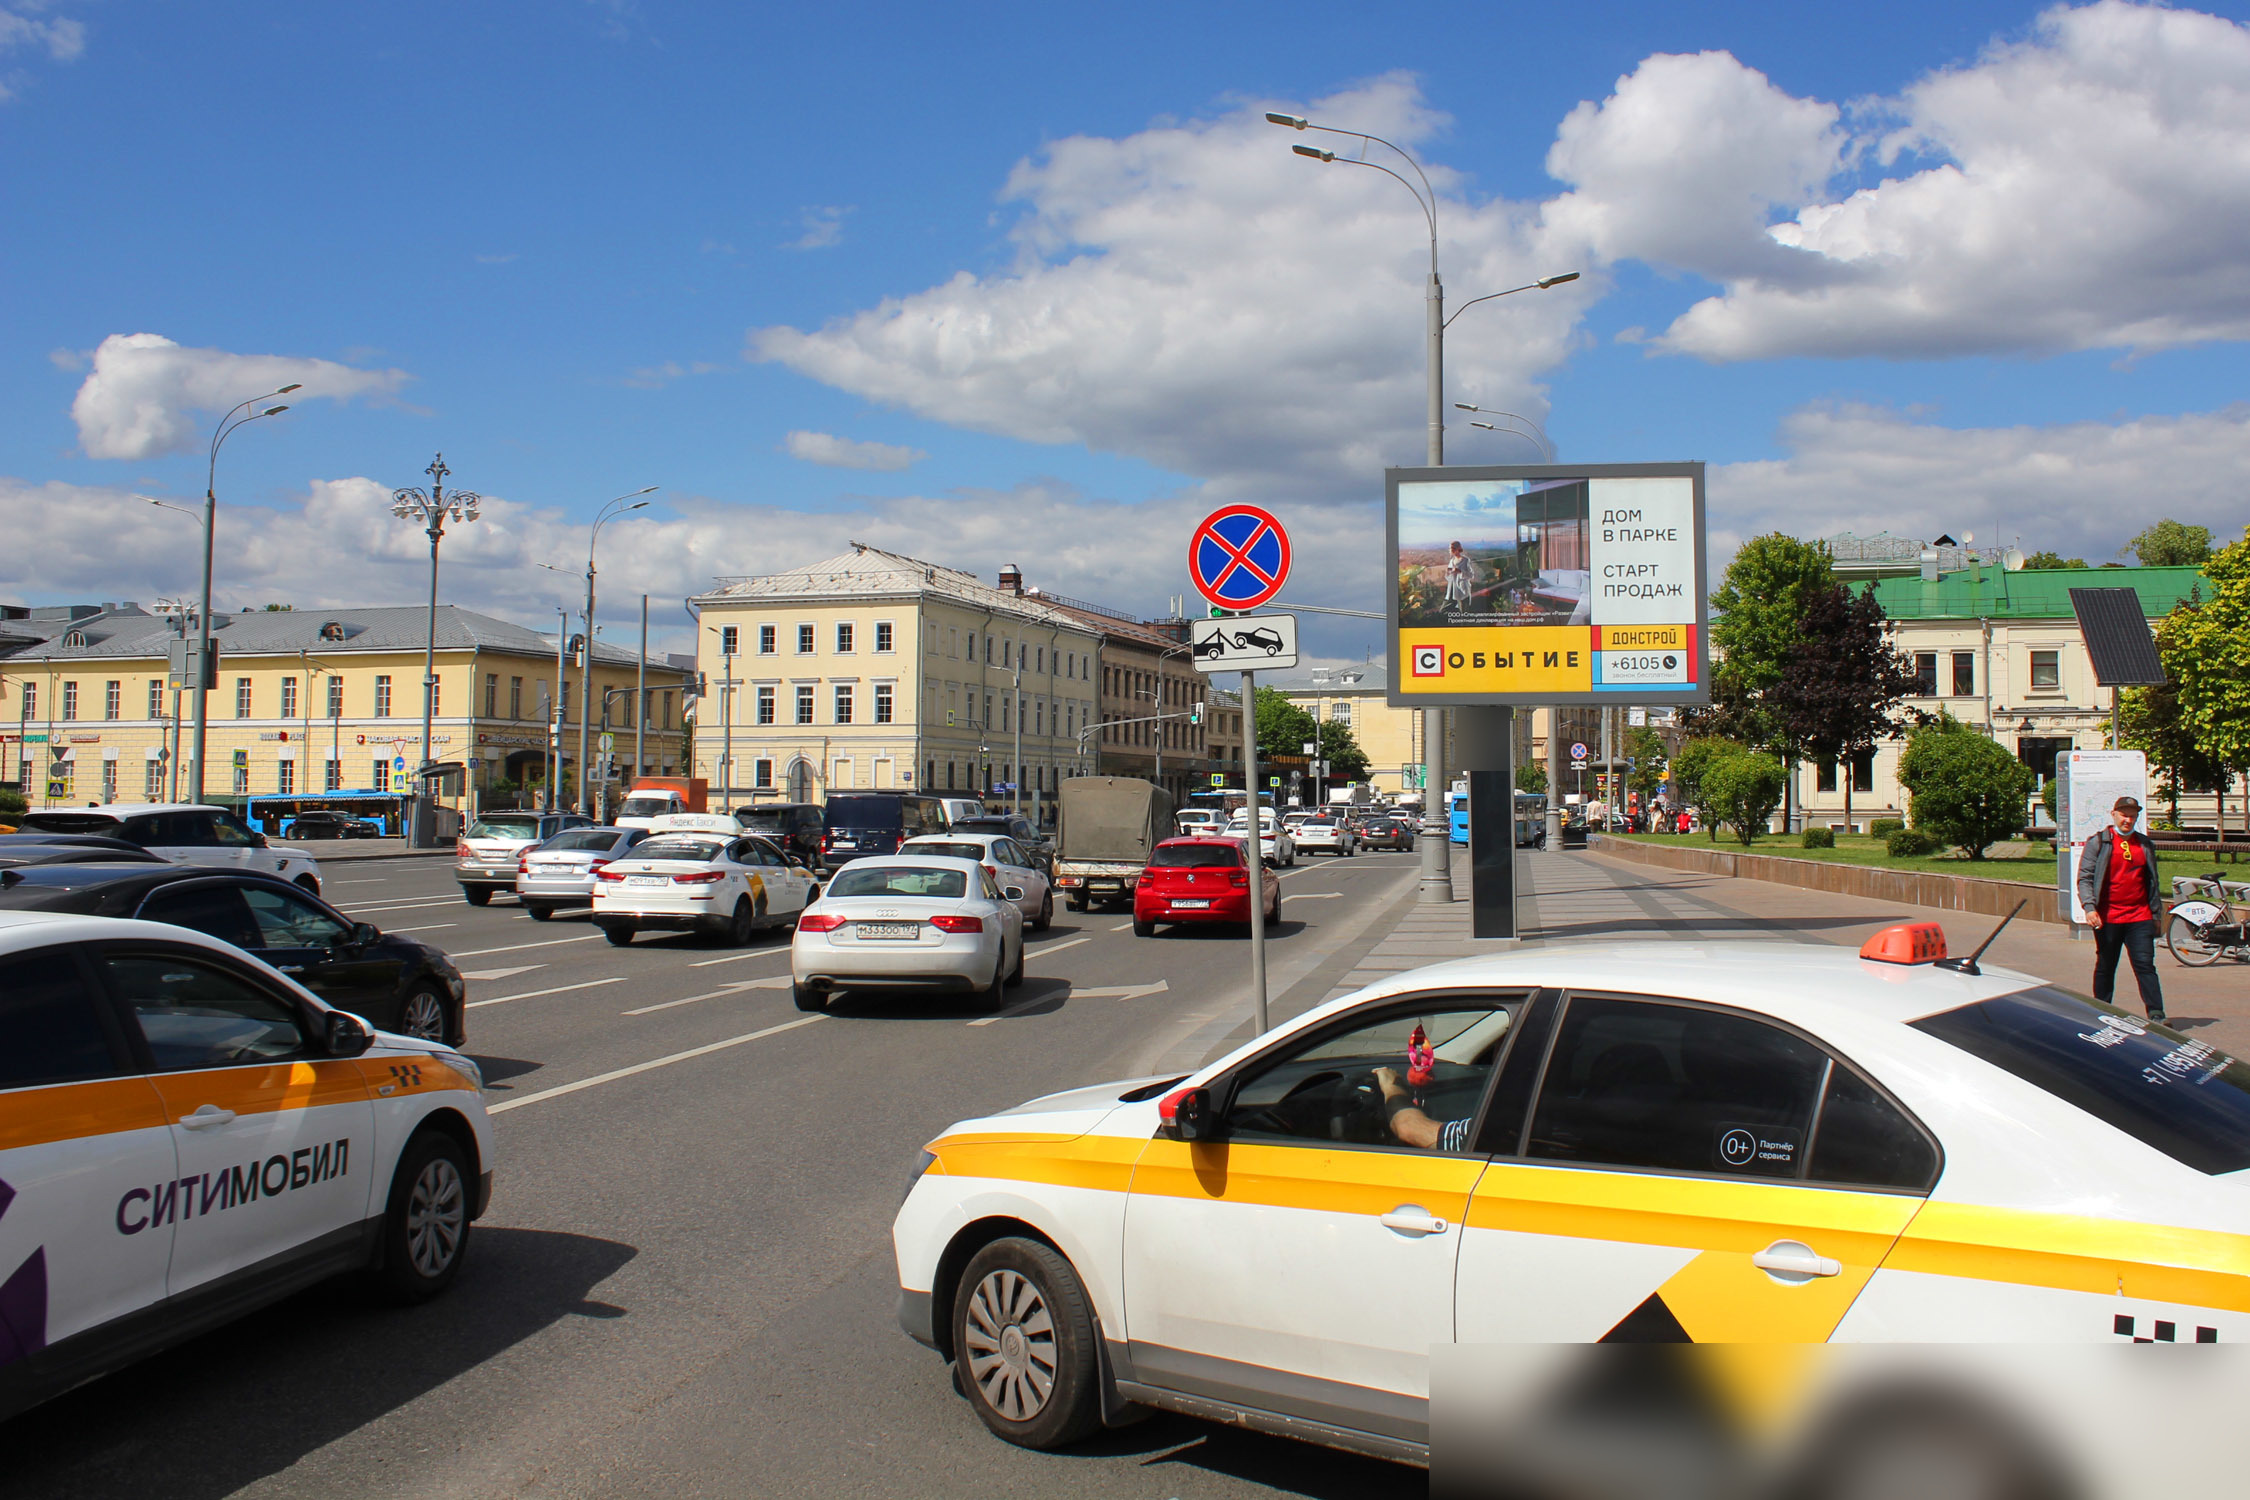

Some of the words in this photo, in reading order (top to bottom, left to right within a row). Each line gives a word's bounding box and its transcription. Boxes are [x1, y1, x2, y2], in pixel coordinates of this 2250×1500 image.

[1602, 510, 1641, 525] ДОМ
[1603, 529, 1614, 542] В
[1619, 528, 1677, 542] ПАРКЕ
[1603, 564, 1659, 577] СТАРТ
[1604, 584, 1683, 599] ПРОДАЖ
[1612, 628, 1677, 645] ДОНСТРОЙ
[1420, 651, 1579, 669] СОБЫТИЕ
[669, 816, 694, 827] Яндекс
[696, 816, 717, 827] Такси
[2191, 907, 2206, 915] ВТБ
[2152, 1051, 2203, 1079] (495)
[2142, 1067, 2171, 1085] +7
[1727, 1137, 1749, 1155] 0+
[1760, 1140, 1794, 1152] Партнёр
[1758, 1151, 1791, 1161] сервиса
[116, 1138, 349, 1236] СИТИМОБИЛ
